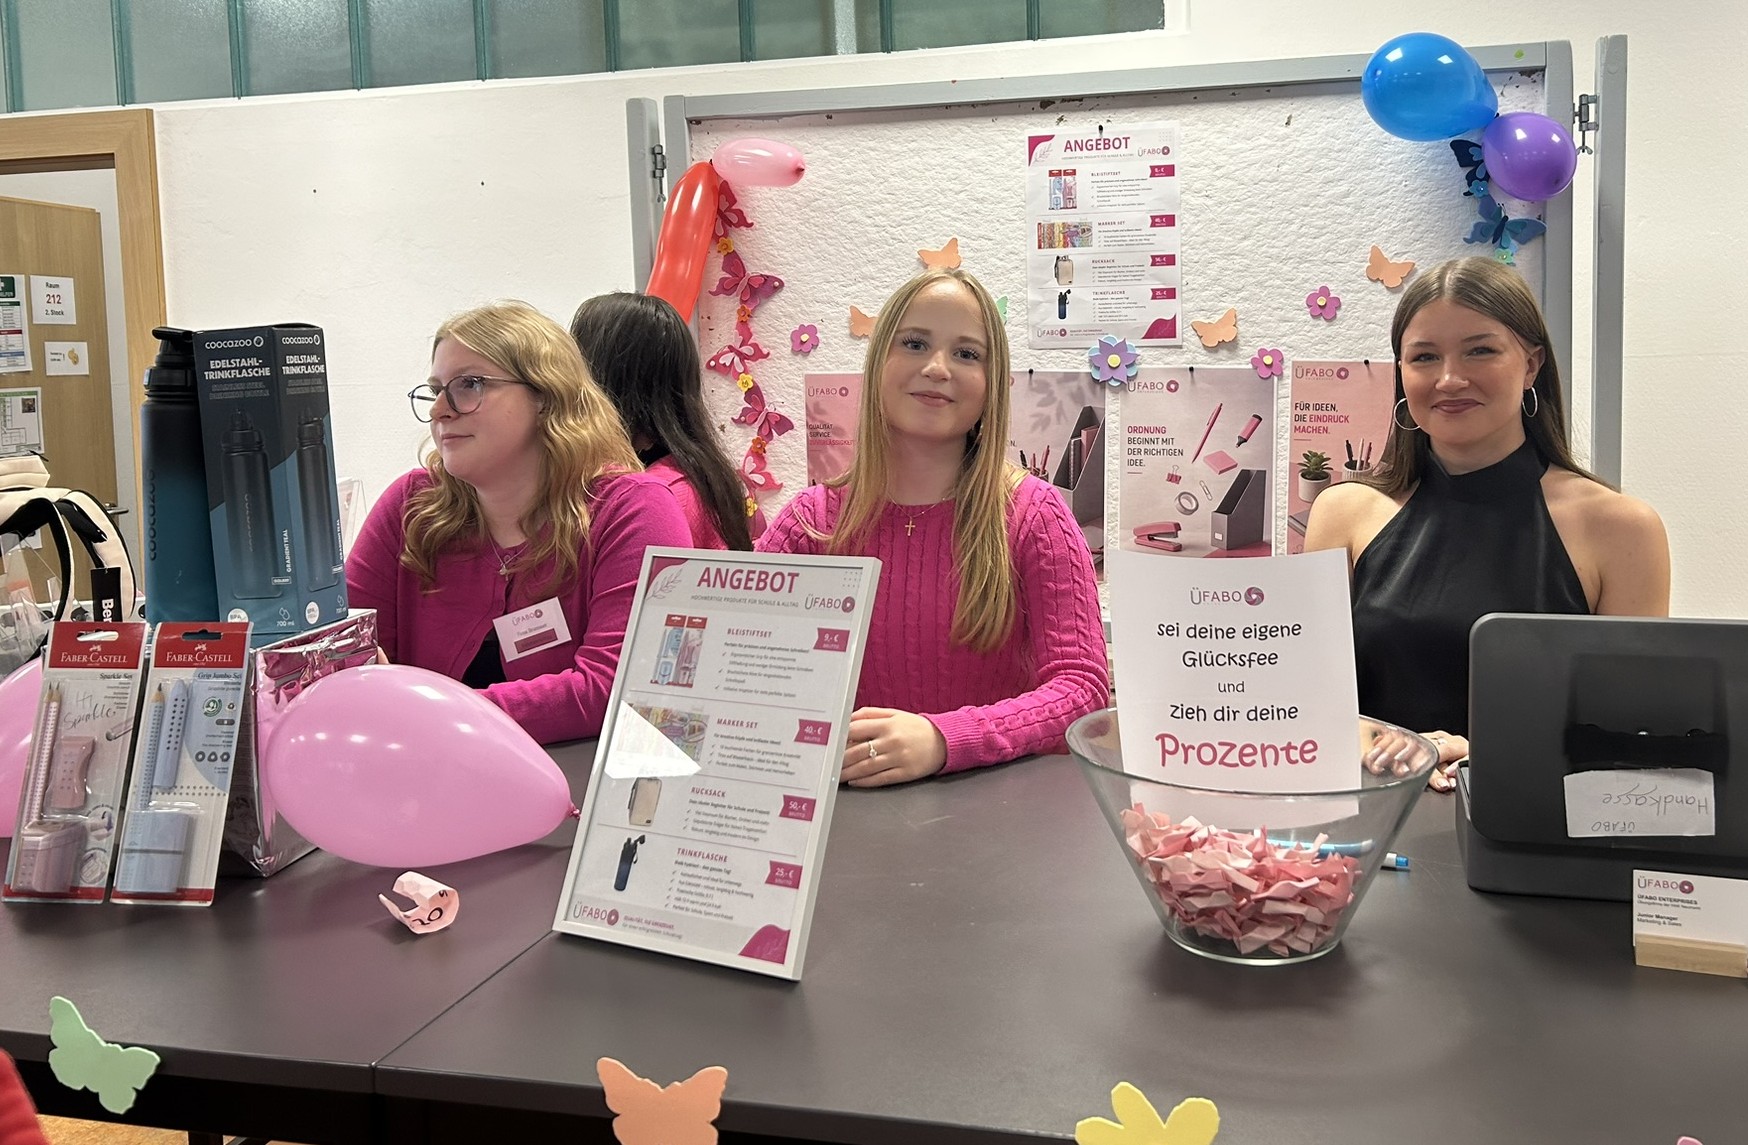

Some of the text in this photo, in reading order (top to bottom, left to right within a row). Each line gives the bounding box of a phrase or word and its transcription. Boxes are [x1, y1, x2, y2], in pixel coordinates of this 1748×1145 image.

[1064, 137, 1130, 152] ANGEBOT
[46, 294, 61, 304] 212
[205, 339, 252, 349] coocazoo
[282, 336, 313, 345] coocazoo
[210, 358, 262, 369] EDELSTAHL-
[286, 355, 320, 364] EDELSTAHL-
[204, 367, 270, 380] TRINKFLASCHE
[282, 365, 324, 374] TRINKFLASCHE
[1295, 366, 1334, 379] ÜFABO
[808, 386, 837, 396] ÜFABO
[1294, 401, 1338, 412] FÜR IDEEN,
[1294, 414, 1350, 424] DIE EINDRUCK
[1127, 425, 1167, 435] ORDNUNG
[1294, 425, 1331, 435] MACHEN.
[1127, 437, 1175, 445] BEGINNT MIT
[1127, 447, 1184, 457] DER RICHTIGEN
[1127, 458, 1146, 467] IDEE.
[697, 567, 800, 593] ANGEBOT
[1190, 587, 1242, 605] ÜFABO
[805, 594, 841, 610] ÜFABO
[726, 628, 772, 637] BLEISTIFTSET
[1157, 622, 1302, 641] sei deine eigene
[1182, 650, 1279, 668] Glücksfee
[1218, 681, 1245, 693] und
[1213, 706, 1240, 722] dir
[1246, 704, 1299, 722] deine
[716, 717, 744, 727] MARKER
[1155, 733, 1318, 768] Prozente
[690, 786, 726, 797] RUCKSACK
[1602, 784, 1708, 815] Handkasse
[1591, 822, 1635, 833] ÜFABO
[676, 847, 728, 862] TRINKFLASCHE
[1638, 876, 1678, 889] ÜFABO
[573, 901, 607, 920] ÜFABO
